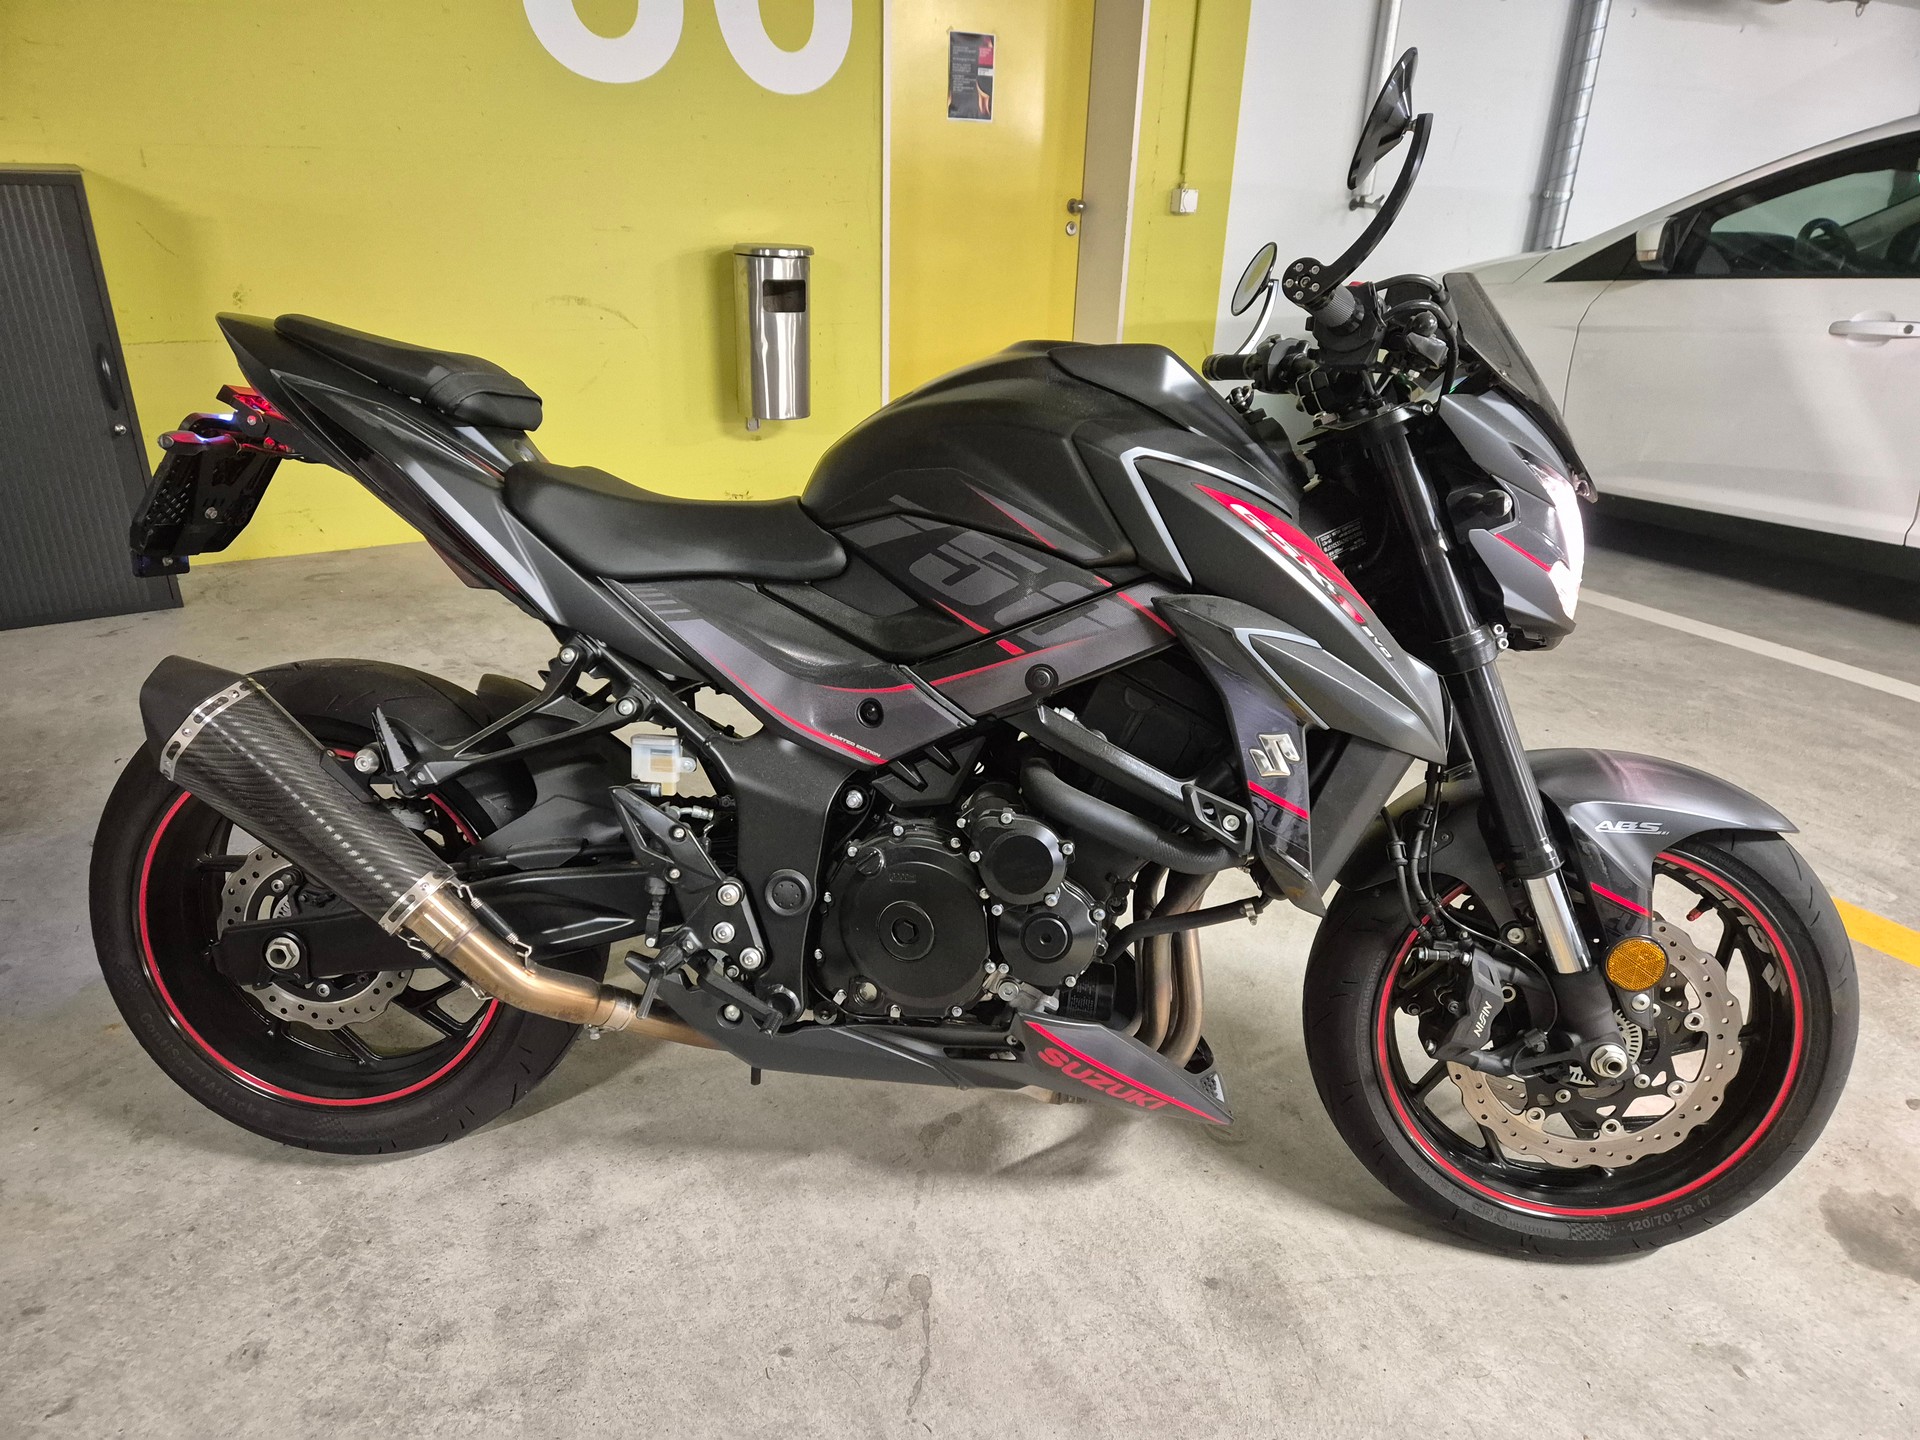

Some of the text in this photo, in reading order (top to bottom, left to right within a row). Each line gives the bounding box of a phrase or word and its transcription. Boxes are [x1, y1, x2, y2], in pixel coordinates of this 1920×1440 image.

[855, 743, 881, 758] EDITION
[1595, 820, 1664, 835] ABS
[1037, 1047, 1168, 1110] SUZUKI
